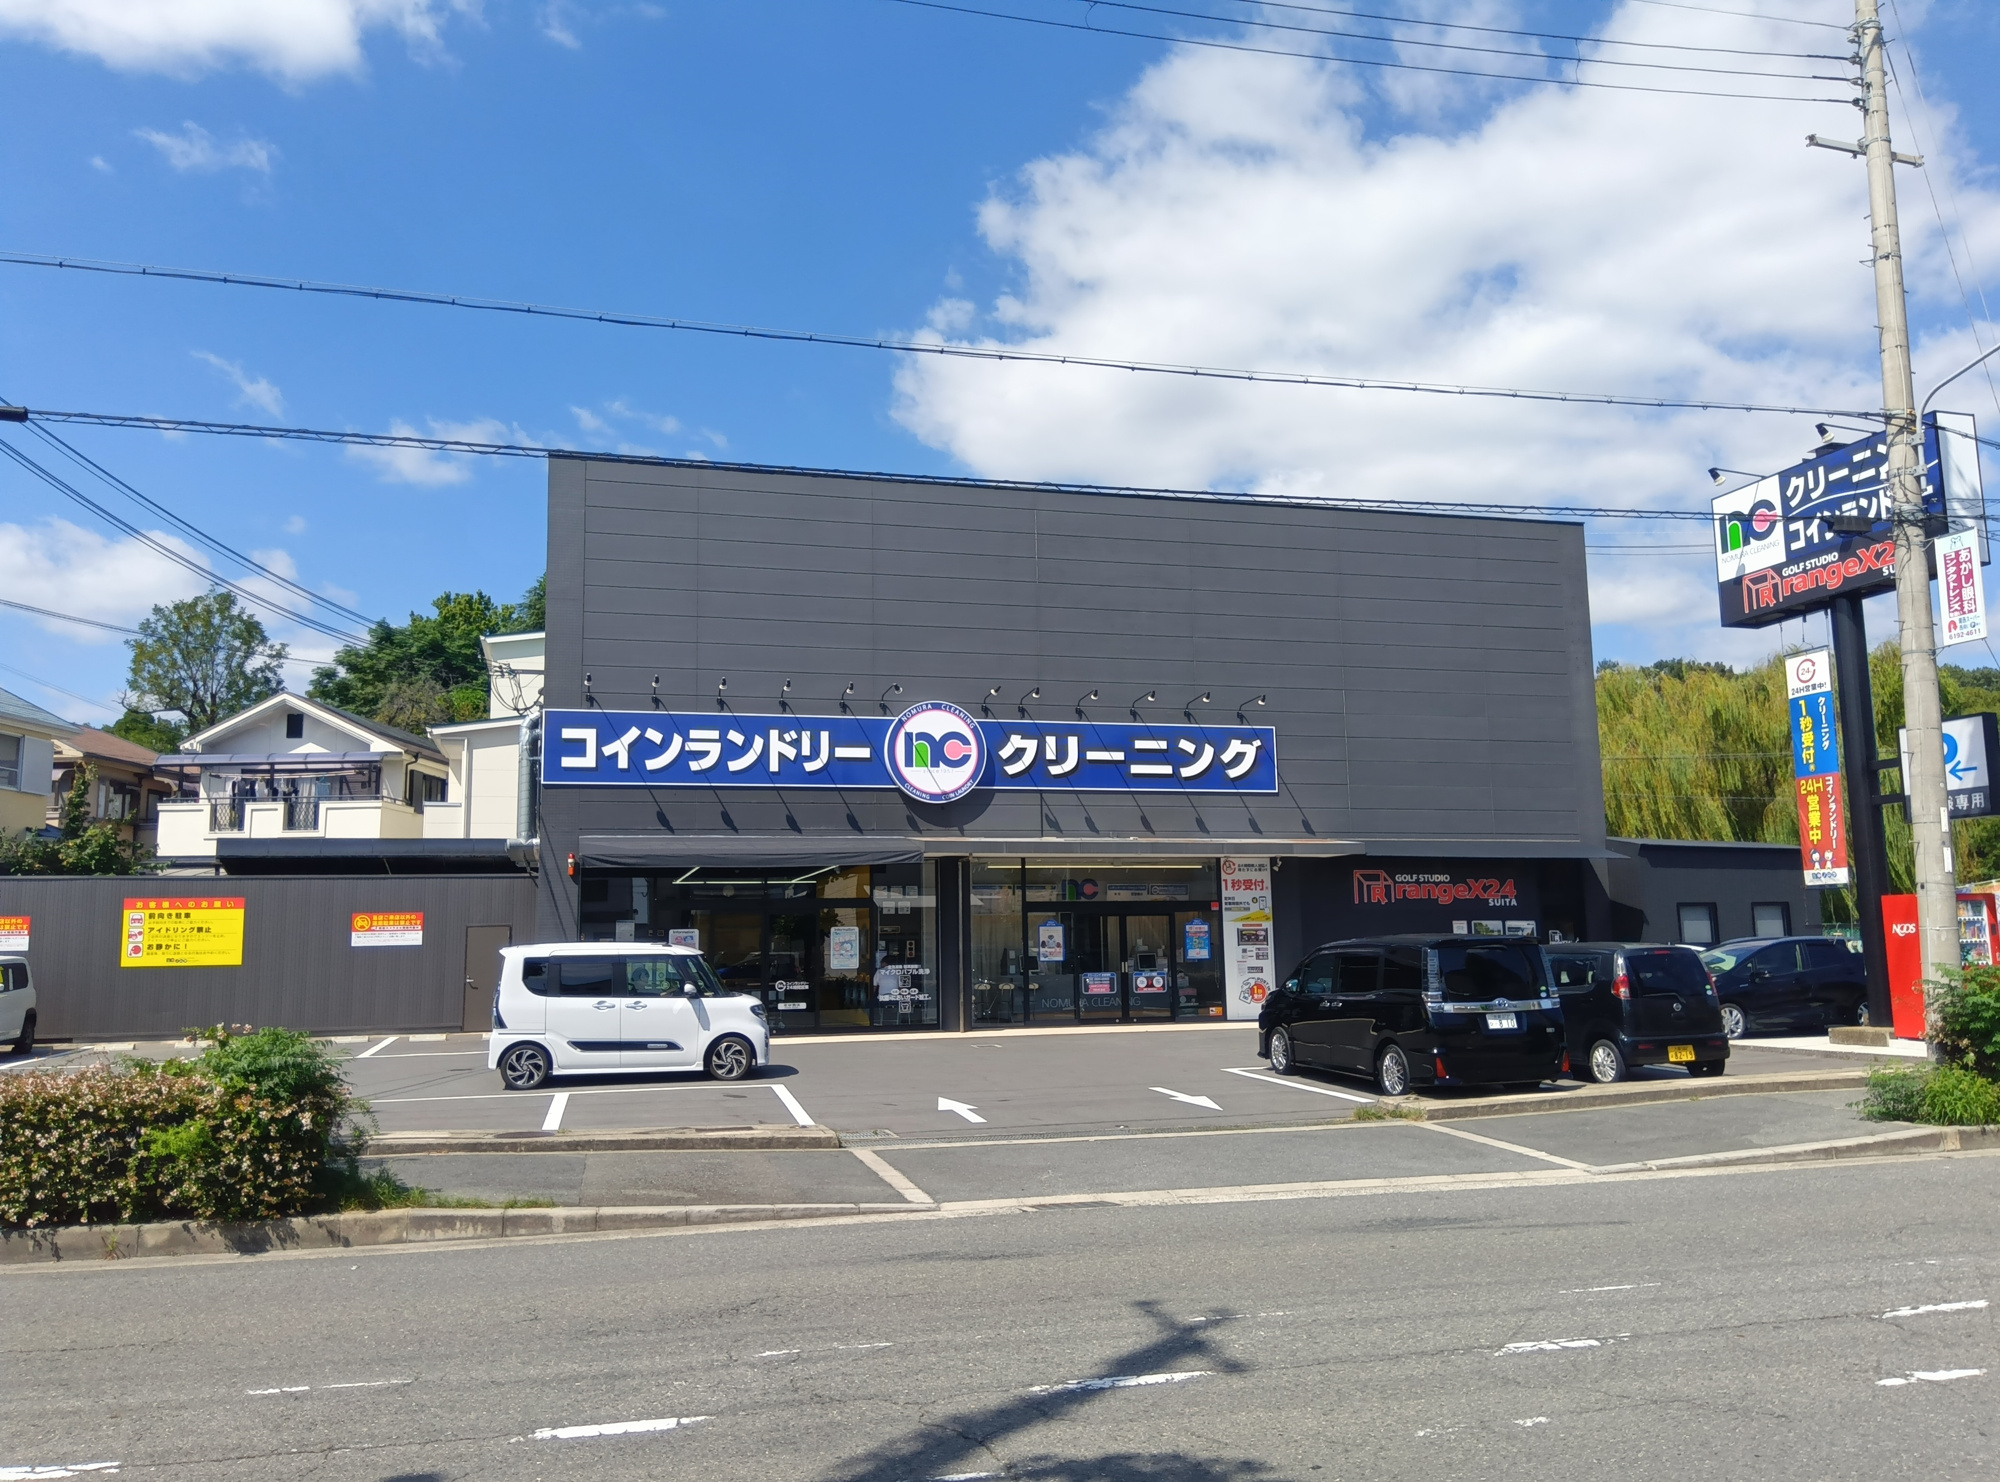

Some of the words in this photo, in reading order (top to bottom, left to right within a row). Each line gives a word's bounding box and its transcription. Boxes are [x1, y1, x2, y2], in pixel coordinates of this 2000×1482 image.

[1721, 550, 1748, 564] NOMURA
[1749, 539, 1780, 555] CLEANING
[1782, 562, 1805, 577] GOLF
[1805, 551, 1839, 570] STUDIO
[1783, 540, 1896, 597] rangeX2
[1958, 548, 1976, 614] あかし眼科
[1945, 551, 1962, 613] コンタクトレンズ
[901, 703, 933, 723] NOMURA
[941, 703, 976, 729] CLEANING
[1818, 696, 1830, 751] クリーニング
[561, 727, 871, 773] コインランドリー
[999, 734, 1262, 780] クリーニング
[904, 782, 931, 800] CLEANING
[942, 790, 956, 800] COIN
[956, 779, 975, 797] LAUNDRY
[1825, 776, 1838, 849] コインランドリー
[1395, 874, 1418, 882] GOLF
[1418, 874, 1450, 882] STUDIO
[135, 901, 235, 909] お客様へのお願い
[1396, 879, 1517, 905] rangeX24
[1488, 898, 1517, 906] SUITA
[148, 912, 192, 920] 前向き駐車
[147, 926, 212, 934] アイドリング禁止
